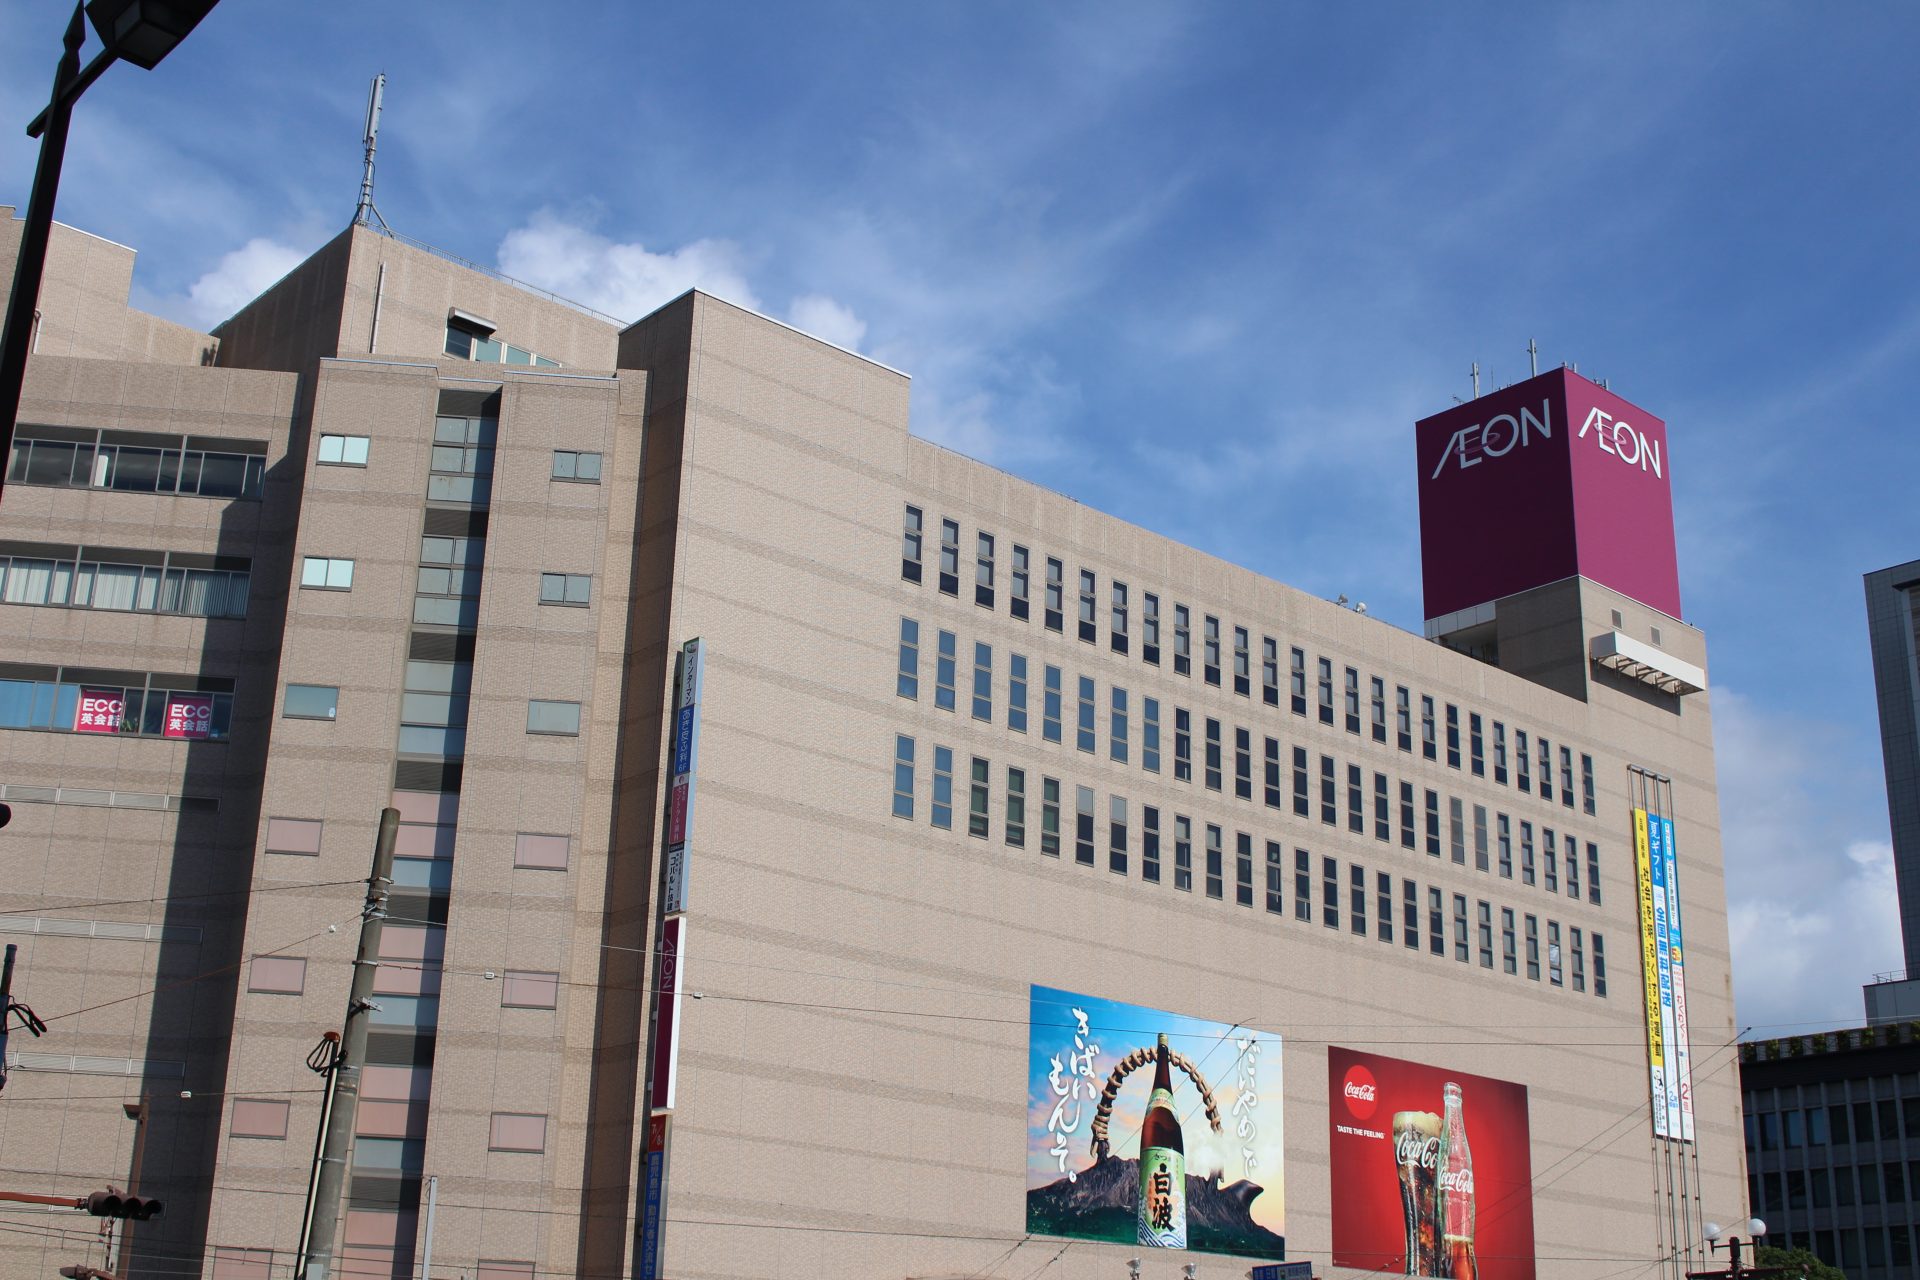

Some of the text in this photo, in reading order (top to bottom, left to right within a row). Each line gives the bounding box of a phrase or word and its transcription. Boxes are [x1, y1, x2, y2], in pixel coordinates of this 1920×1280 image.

[82, 698, 122, 713] ECC
[170, 703, 210, 719] ECC
[80, 712, 120, 727] 英会話
[169, 718, 209, 732] 英会話
[679, 709, 691, 763] あき皮ふ科
[1649, 820, 1662, 881] 夏ギフト
[1344, 1081, 1376, 1102] Coca-Cola
[1336, 1125, 1385, 1139] TASTE THE FEELING
[1151, 1162, 1175, 1233] 白波
